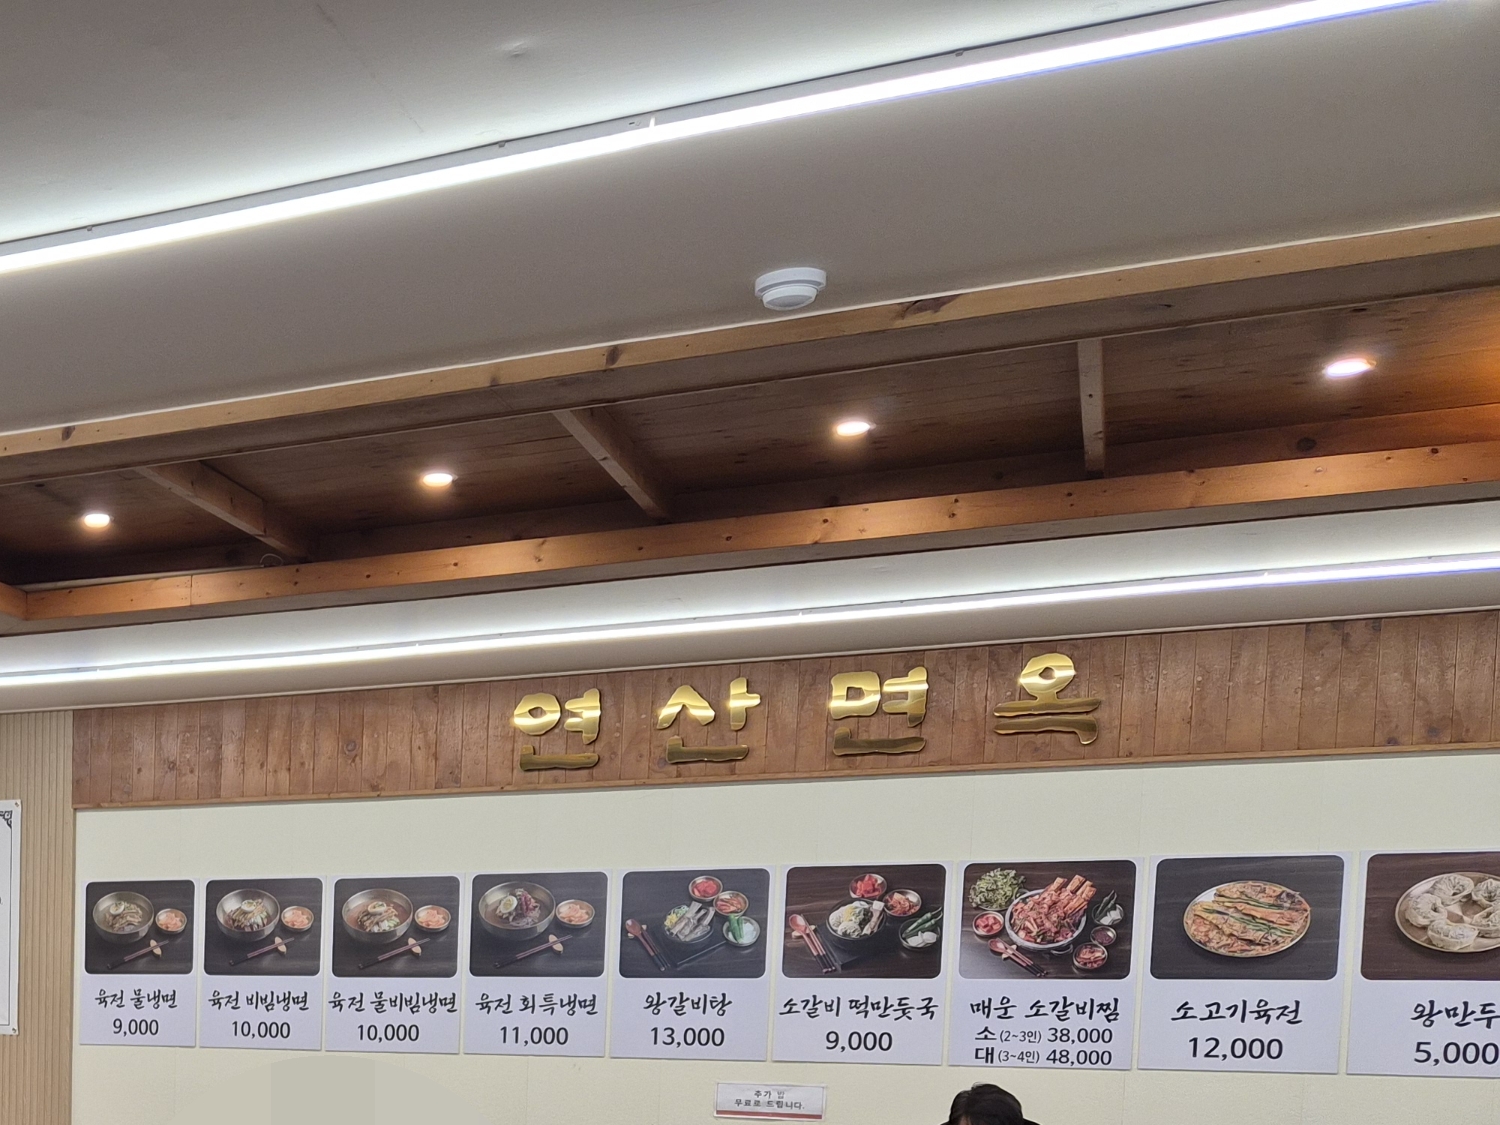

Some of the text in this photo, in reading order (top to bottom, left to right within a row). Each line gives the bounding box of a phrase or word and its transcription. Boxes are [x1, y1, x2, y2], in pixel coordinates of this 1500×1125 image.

[512, 652, 1100, 771] 연산면옥
[95, 989, 177, 1009] 육전 물냉면
[208, 990, 309, 1012] 육전 비빔냉면
[329, 991, 457, 1014] 육전 물비빔냉면
[476, 993, 513, 1014] 육전
[644, 992, 732, 1016] 왕갈비탕
[779, 995, 938, 1021] 소갈비 떡만둣국
[970, 996, 1119, 1023] 매운 소갈비찜
[1171, 999, 1302, 1024] 소고기육전
[1411, 1000, 1500, 1029] 왕만두
[113, 1019, 158, 1036] 9,000
[233, 1021, 290, 1038] 10,000
[358, 1024, 419, 1043] 10,000
[501, 1027, 568, 1046] 11,000
[651, 1027, 724, 1048] 13,000
[975, 1026, 1112, 1044] 소 (2~3인) 38,000
[826, 1031, 892, 1052] 9,000
[1189, 1037, 1283, 1061] 12,000
[975, 1047, 1112, 1066] 대 (3~4인) 48,000
[1414, 1042, 1499, 1066] 5,000
[734, 1099, 805, 1110] 무료로 드립니다.
[754, 1090, 772, 1099] 추가
